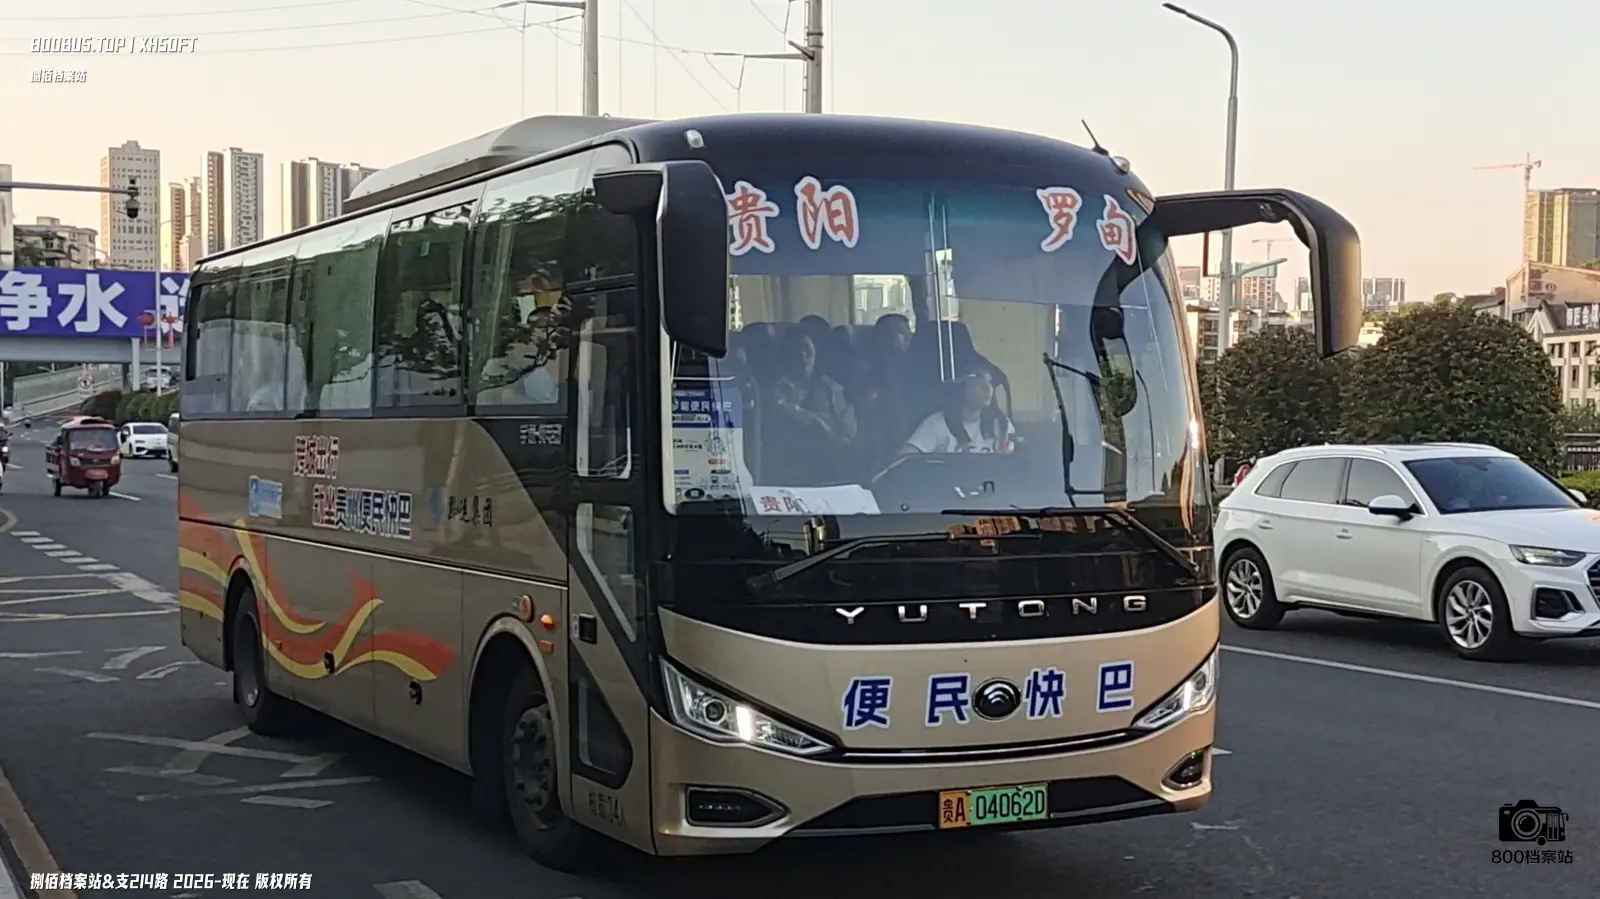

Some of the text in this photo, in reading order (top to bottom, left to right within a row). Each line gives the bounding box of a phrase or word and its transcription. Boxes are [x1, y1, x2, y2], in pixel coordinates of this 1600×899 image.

[728, 176, 1138, 266] 贵阳 罗甸
[835, 595, 1147, 624] YUTONG
[842, 660, 1136, 730] 便民快巴
[974, 788, 1046, 822] 04062D
